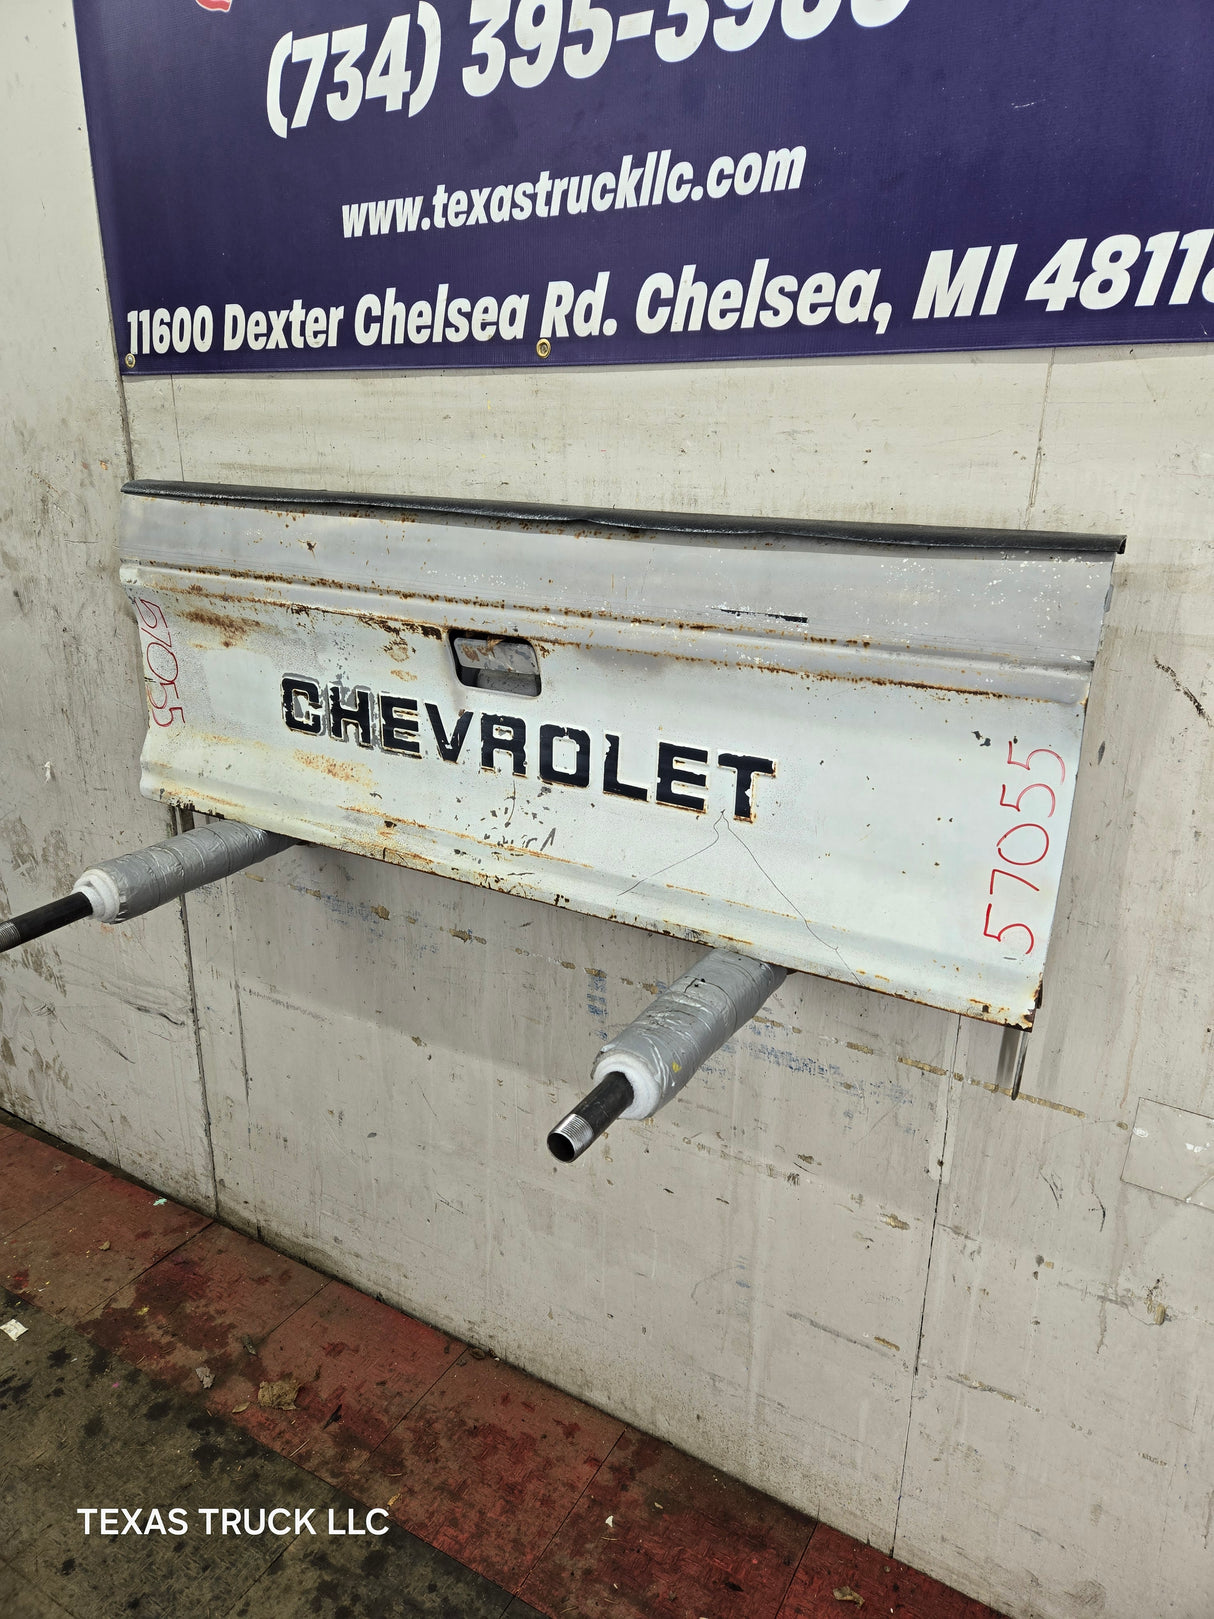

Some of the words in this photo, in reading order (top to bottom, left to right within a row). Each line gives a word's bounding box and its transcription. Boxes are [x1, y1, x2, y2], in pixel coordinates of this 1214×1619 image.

[266, 0, 442, 139] (734)
[462, 0, 909, 98] 395-5
[341, 146, 807, 239] www.texastruckllc.com
[127, 304, 214, 354] 11600
[224, 299, 345, 351] Dexter
[355, 287, 530, 346] Chelsea
[540, 271, 618, 338] Rd.
[636, 258, 893, 335] Chelsea,
[913, 243, 1019, 320] MI
[1024, 228, 1214, 312] 4811
[133, 596, 186, 727] 57055
[281, 674, 777, 823] CHEVROLET
[984, 740, 1066, 955] 57055
